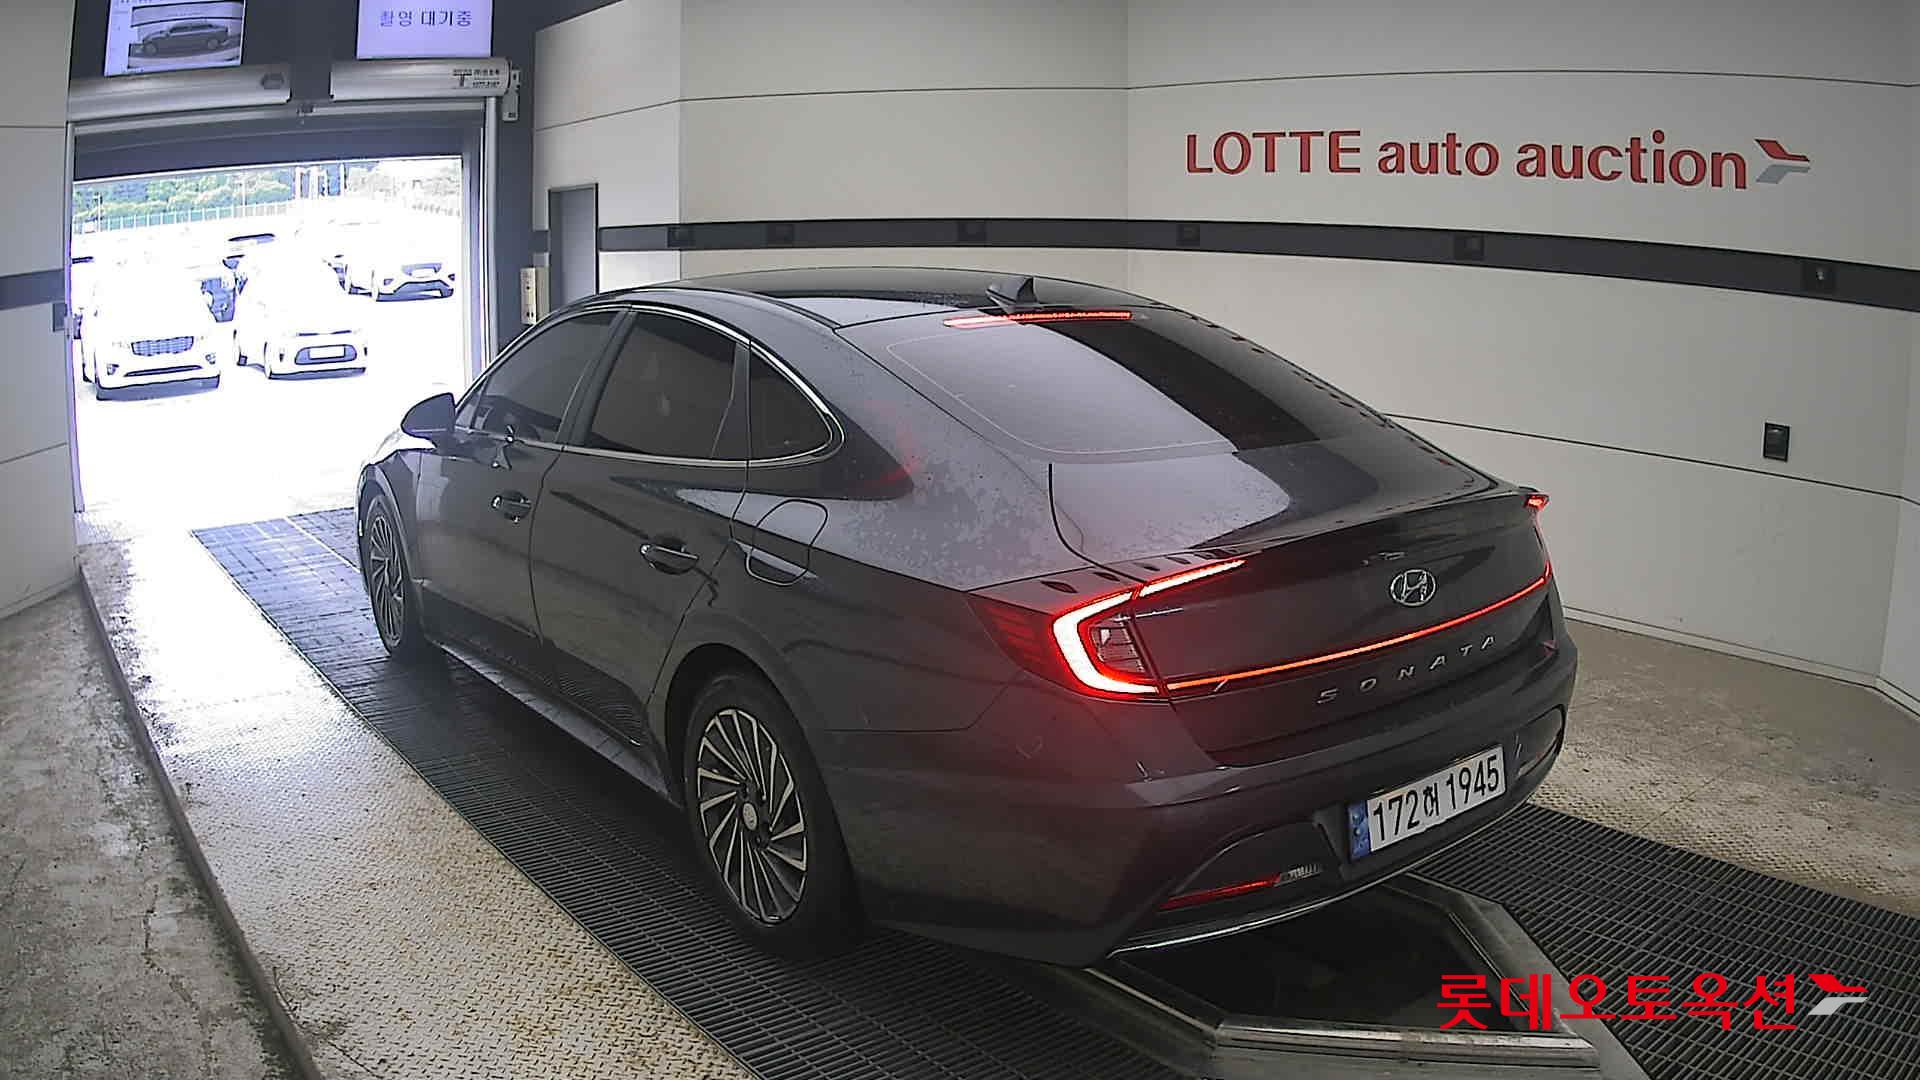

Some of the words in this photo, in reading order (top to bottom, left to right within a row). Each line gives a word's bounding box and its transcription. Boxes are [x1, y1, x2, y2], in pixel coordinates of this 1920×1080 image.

[421, 10, 472, 27] 대기중
[1186, 130, 1361, 174] LOTTE
[1377, 132, 1500, 176] auto
[1515, 129, 1747, 189] auction
[1317, 635, 1496, 704] SONATA
[1446, 754, 1500, 810] 1945
